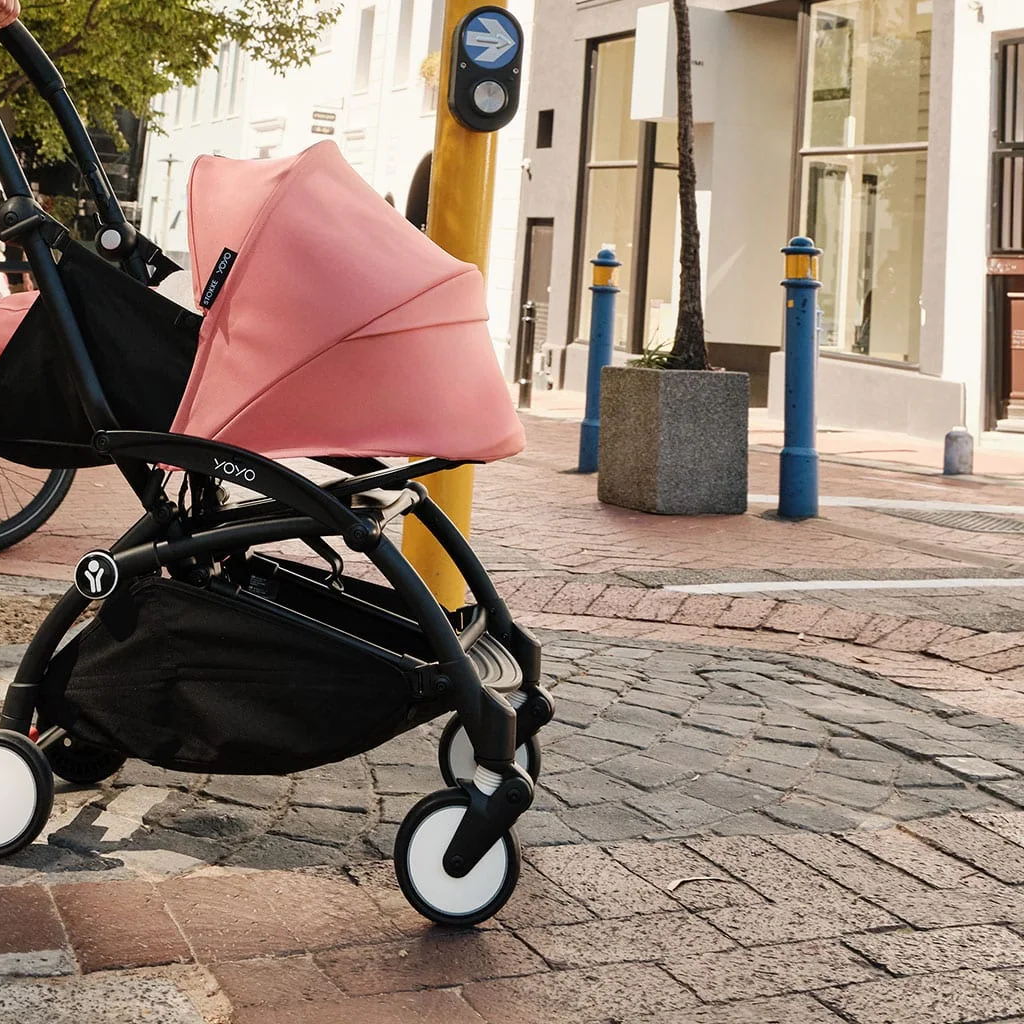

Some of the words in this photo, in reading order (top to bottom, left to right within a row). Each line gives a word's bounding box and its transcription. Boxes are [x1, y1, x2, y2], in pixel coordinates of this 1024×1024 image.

[203, 279, 219, 306] STOKKE
[216, 252, 232, 274] YOYO
[214, 458, 256, 482] YOYO
